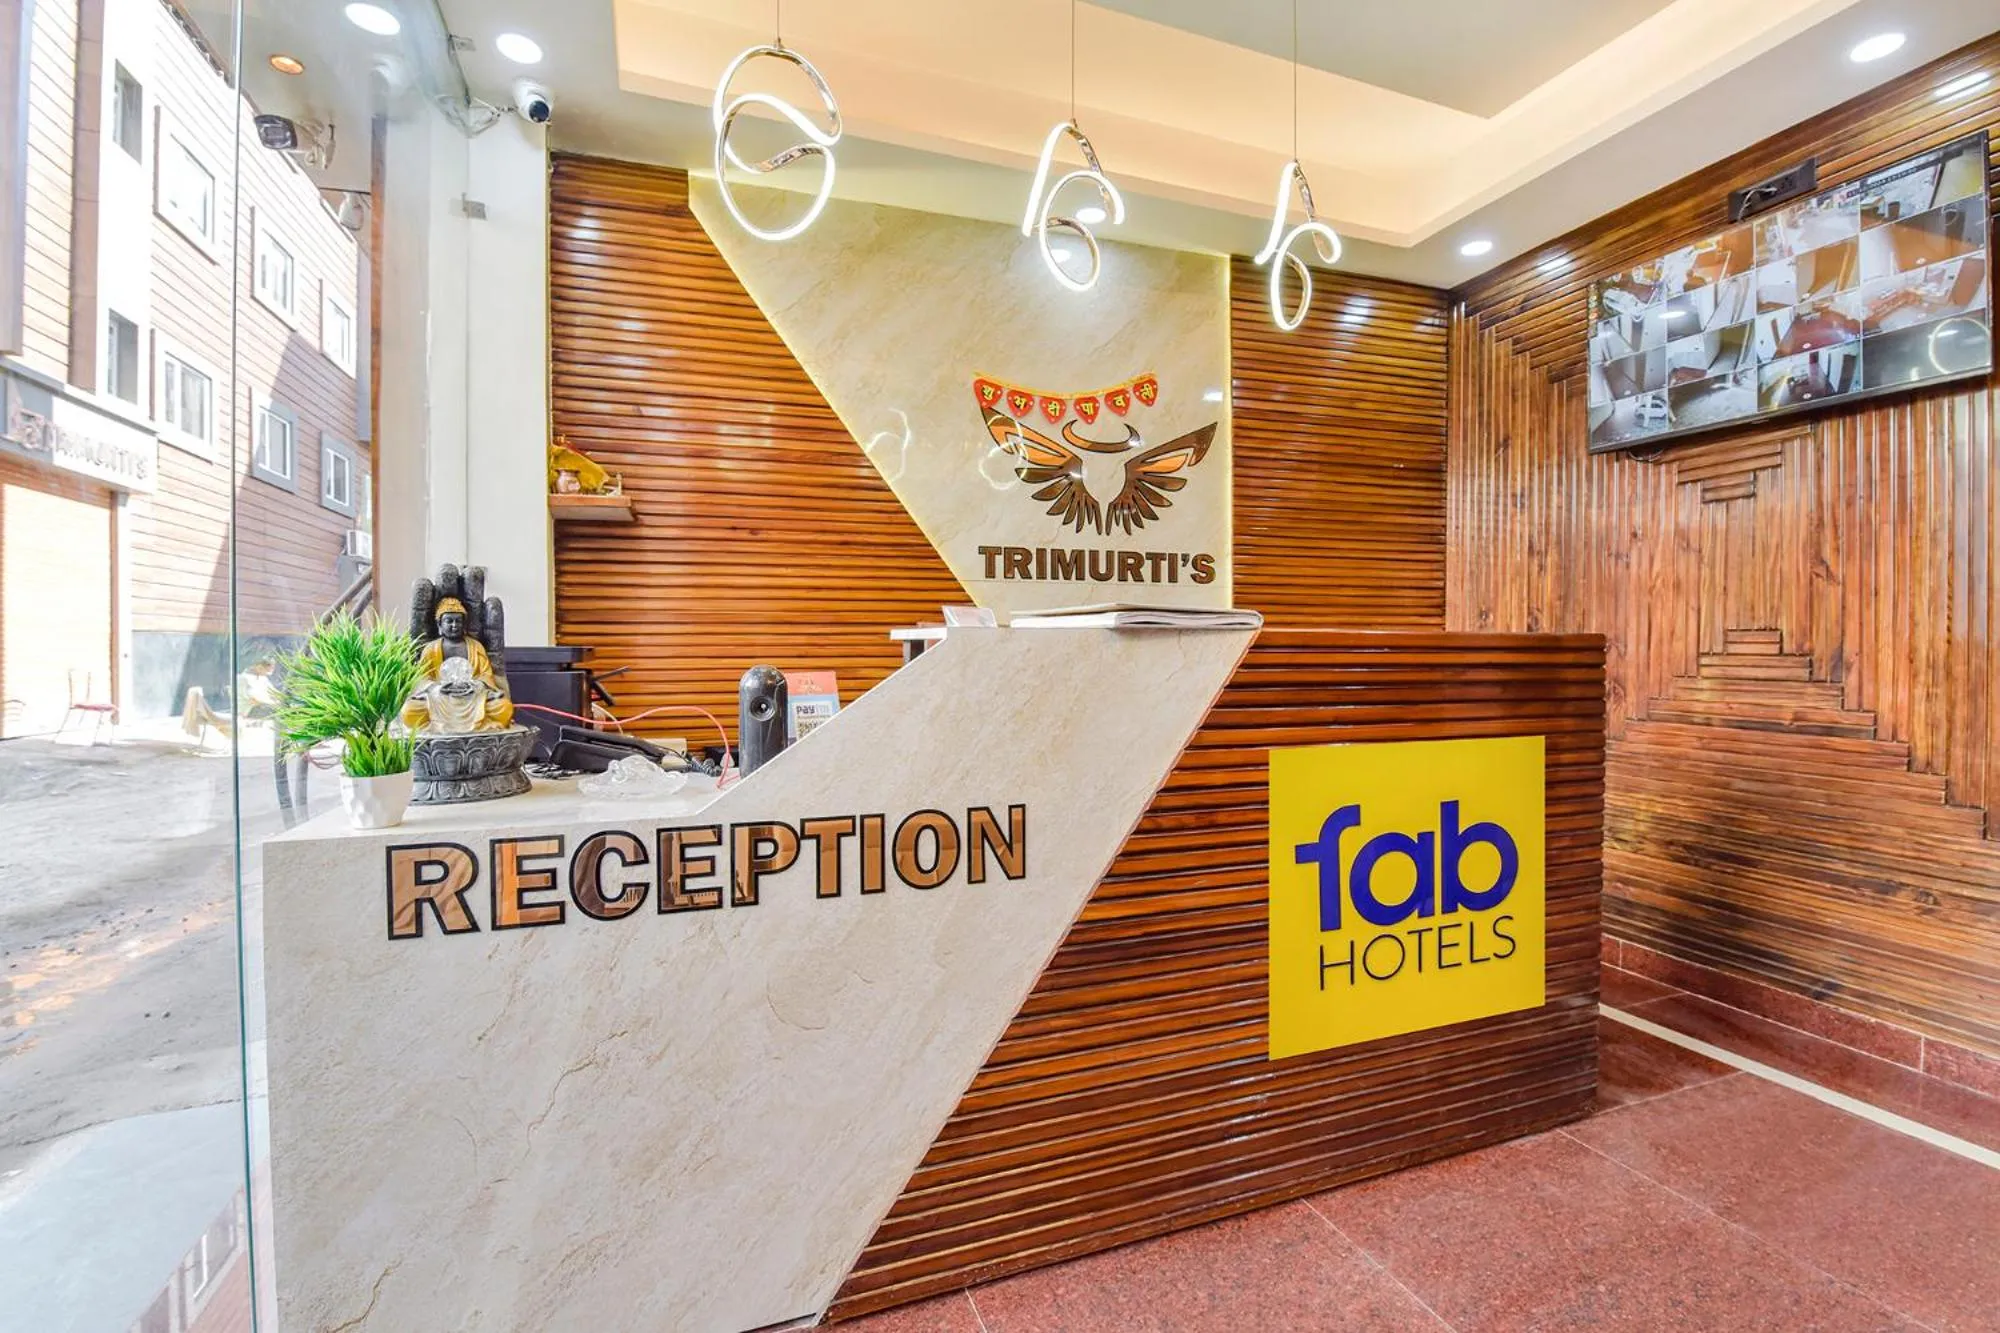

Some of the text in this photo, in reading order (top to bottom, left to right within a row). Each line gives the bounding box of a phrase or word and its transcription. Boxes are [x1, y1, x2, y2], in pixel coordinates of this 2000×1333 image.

[977, 545, 1216, 585] TRIMURTI'S
[386, 803, 1027, 942] RECEPTION
[1294, 799, 1520, 933] fab
[1319, 914, 1517, 992] HOTELS
